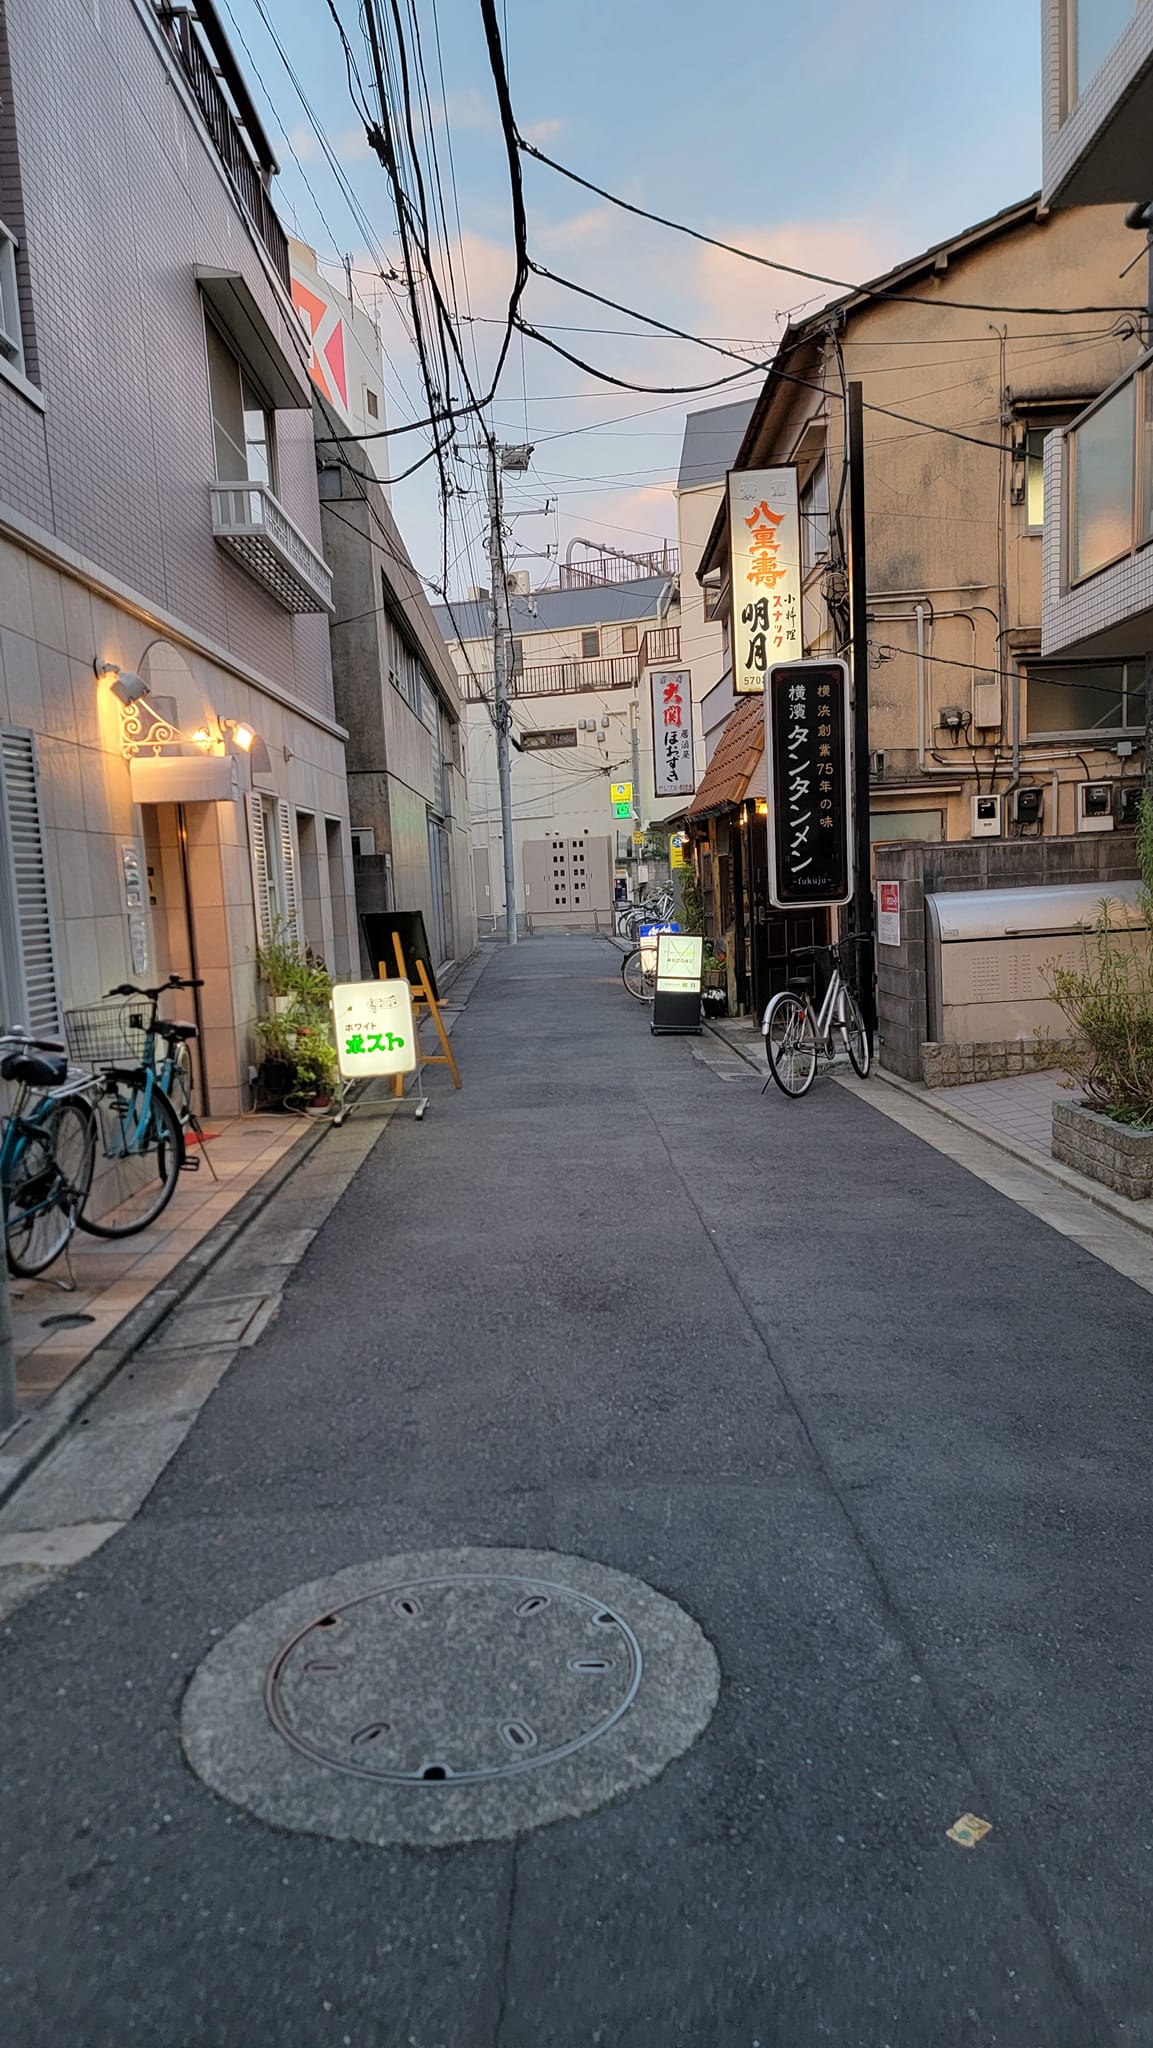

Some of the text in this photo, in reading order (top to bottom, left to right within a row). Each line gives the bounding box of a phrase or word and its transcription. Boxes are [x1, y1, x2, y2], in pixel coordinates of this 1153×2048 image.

[744, 500, 787, 589] 八重寿
[742, 597, 769, 671] 明月
[773, 595, 783, 648] スナック
[784, 593, 796, 641] 小料理
[663, 682, 682, 728] 大関
[664, 730, 681, 783] ほおずき
[788, 684, 813, 873] 横濱タンタンメン
[817, 684, 834, 828] 横浜創業75年の味
[345, 1022, 377, 1031] ホワイト
